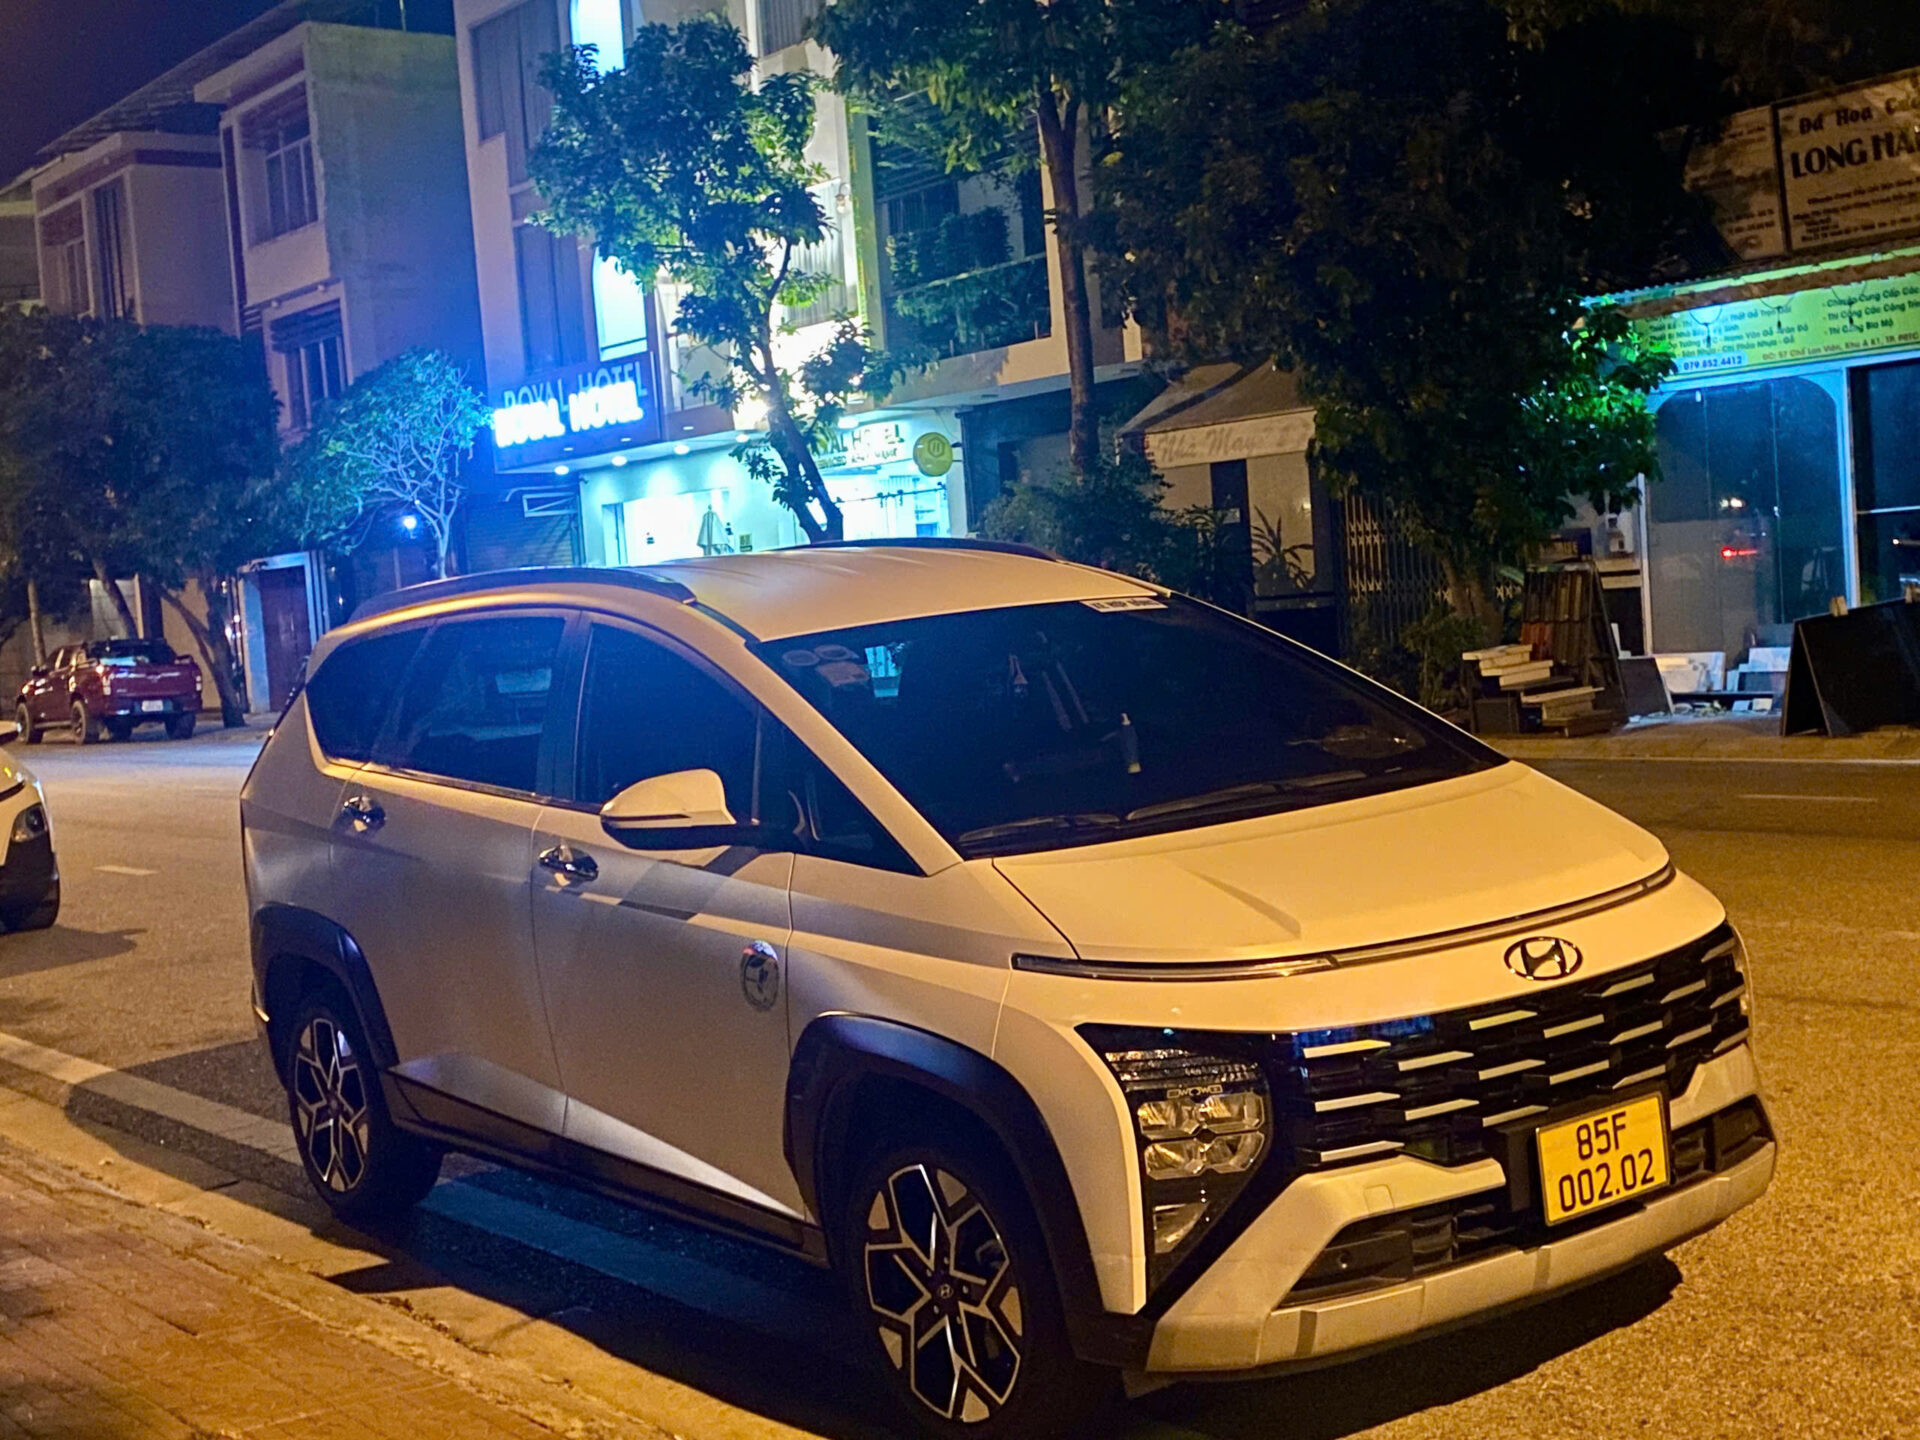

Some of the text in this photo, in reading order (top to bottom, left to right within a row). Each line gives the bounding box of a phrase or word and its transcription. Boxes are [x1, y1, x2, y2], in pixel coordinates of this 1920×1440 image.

[1791, 138, 1868, 179] LONG
[1576, 1110, 1627, 1160] 85F
[1558, 1148, 1655, 1213] 002.02
